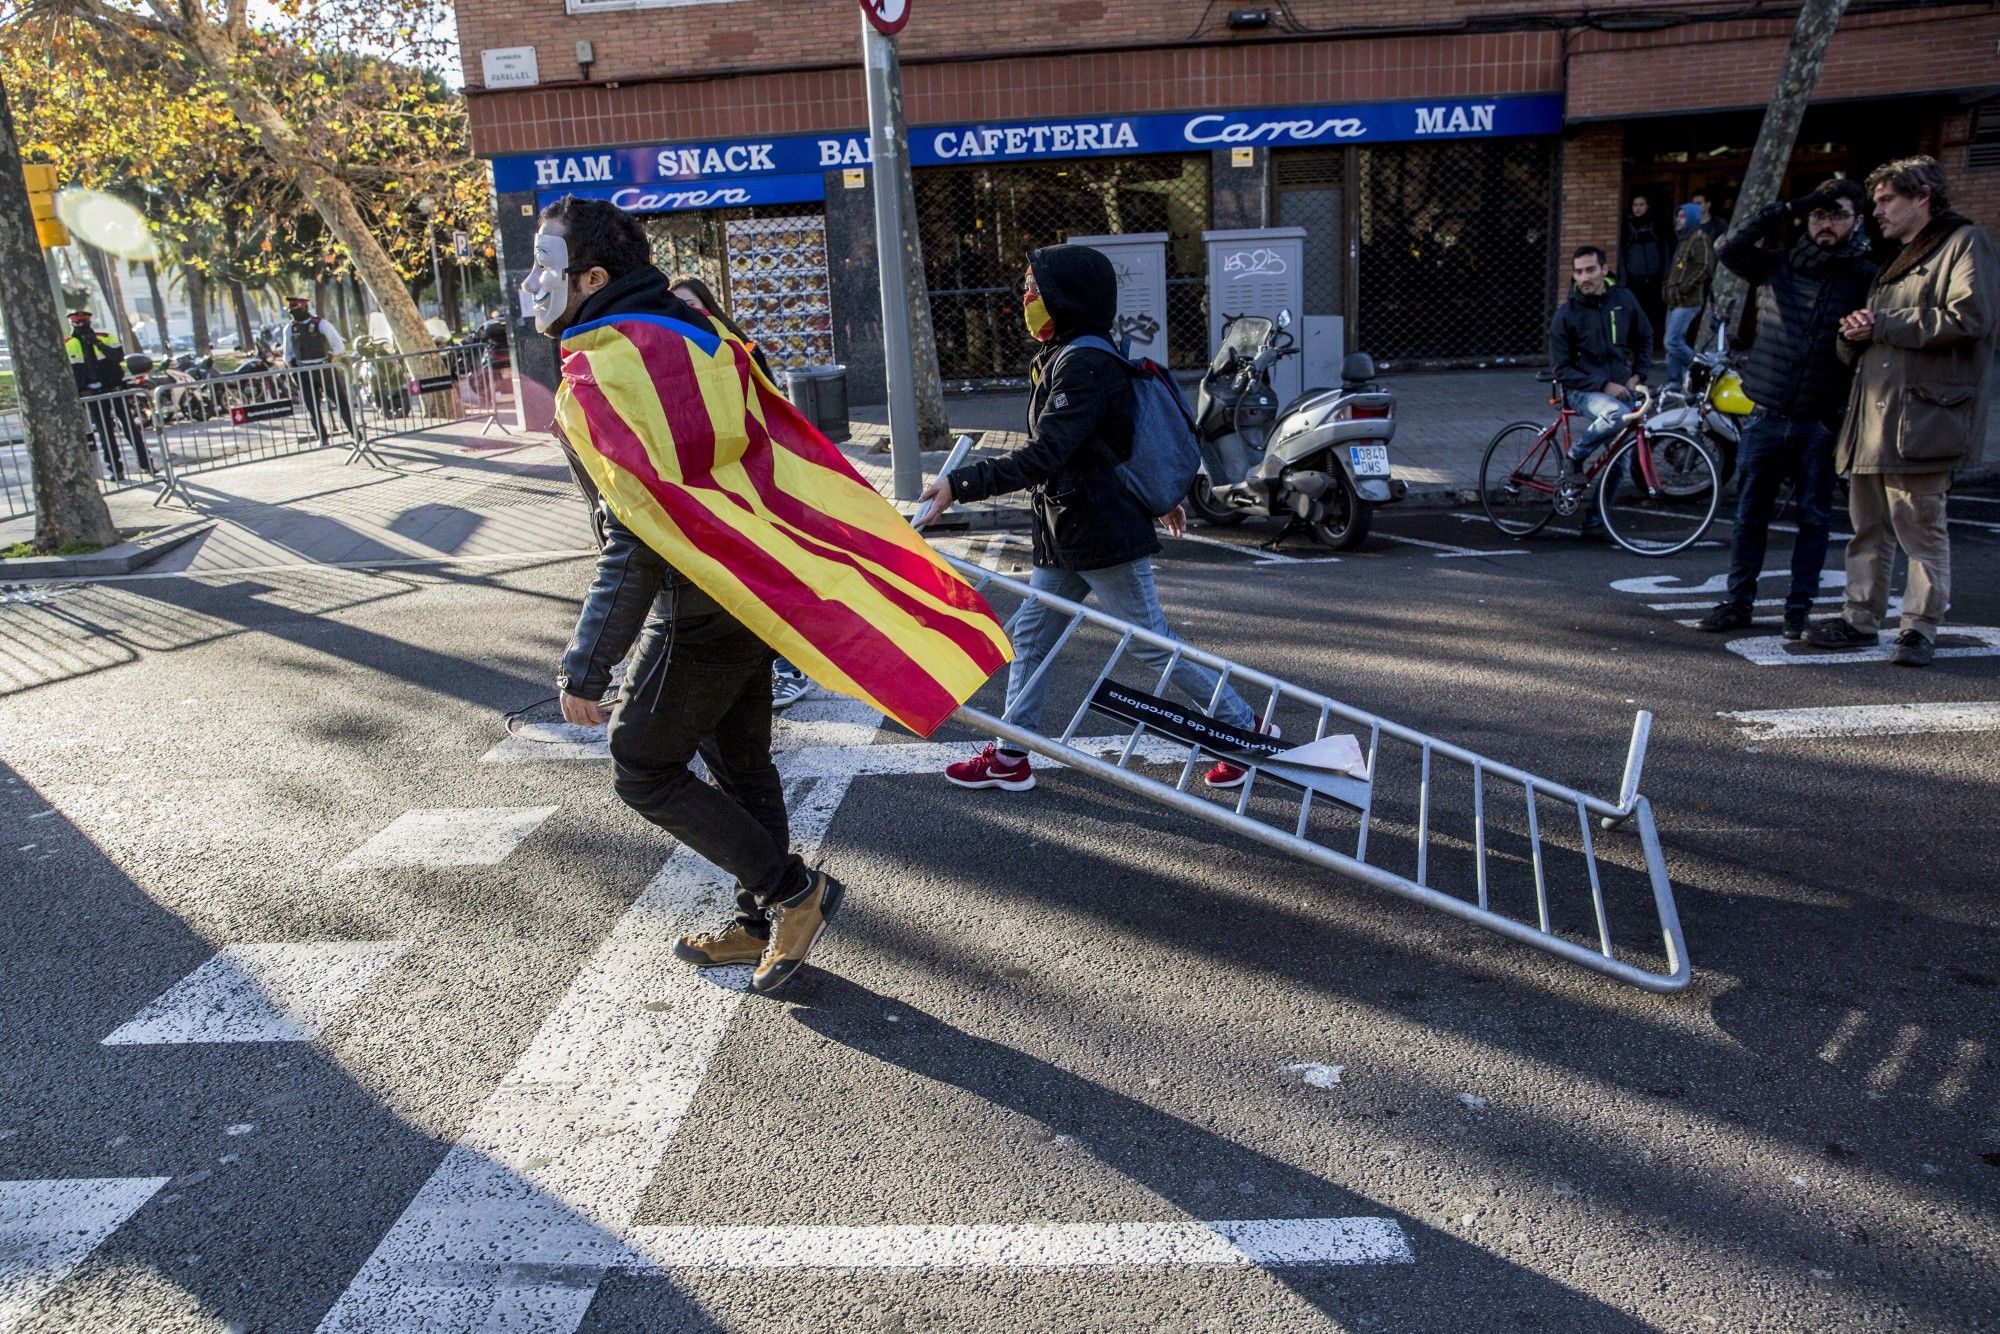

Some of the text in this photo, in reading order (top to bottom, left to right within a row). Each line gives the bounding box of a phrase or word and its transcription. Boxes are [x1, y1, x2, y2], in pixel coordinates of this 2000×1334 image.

[1184, 115, 1367, 143] Carrera
[1415, 105, 1496, 134] MAN
[535, 155, 614, 185] HAM
[658, 144, 776, 177] SNACK
[934, 122, 1139, 159] CAFETERIA
[611, 187, 751, 211] Carrera
[1359, 448, 1386, 460] 0840
[1361, 461, 1382, 474] DMS
[1109, 690, 1185, 724] Barcelona
[1187, 719, 1206, 732] de
